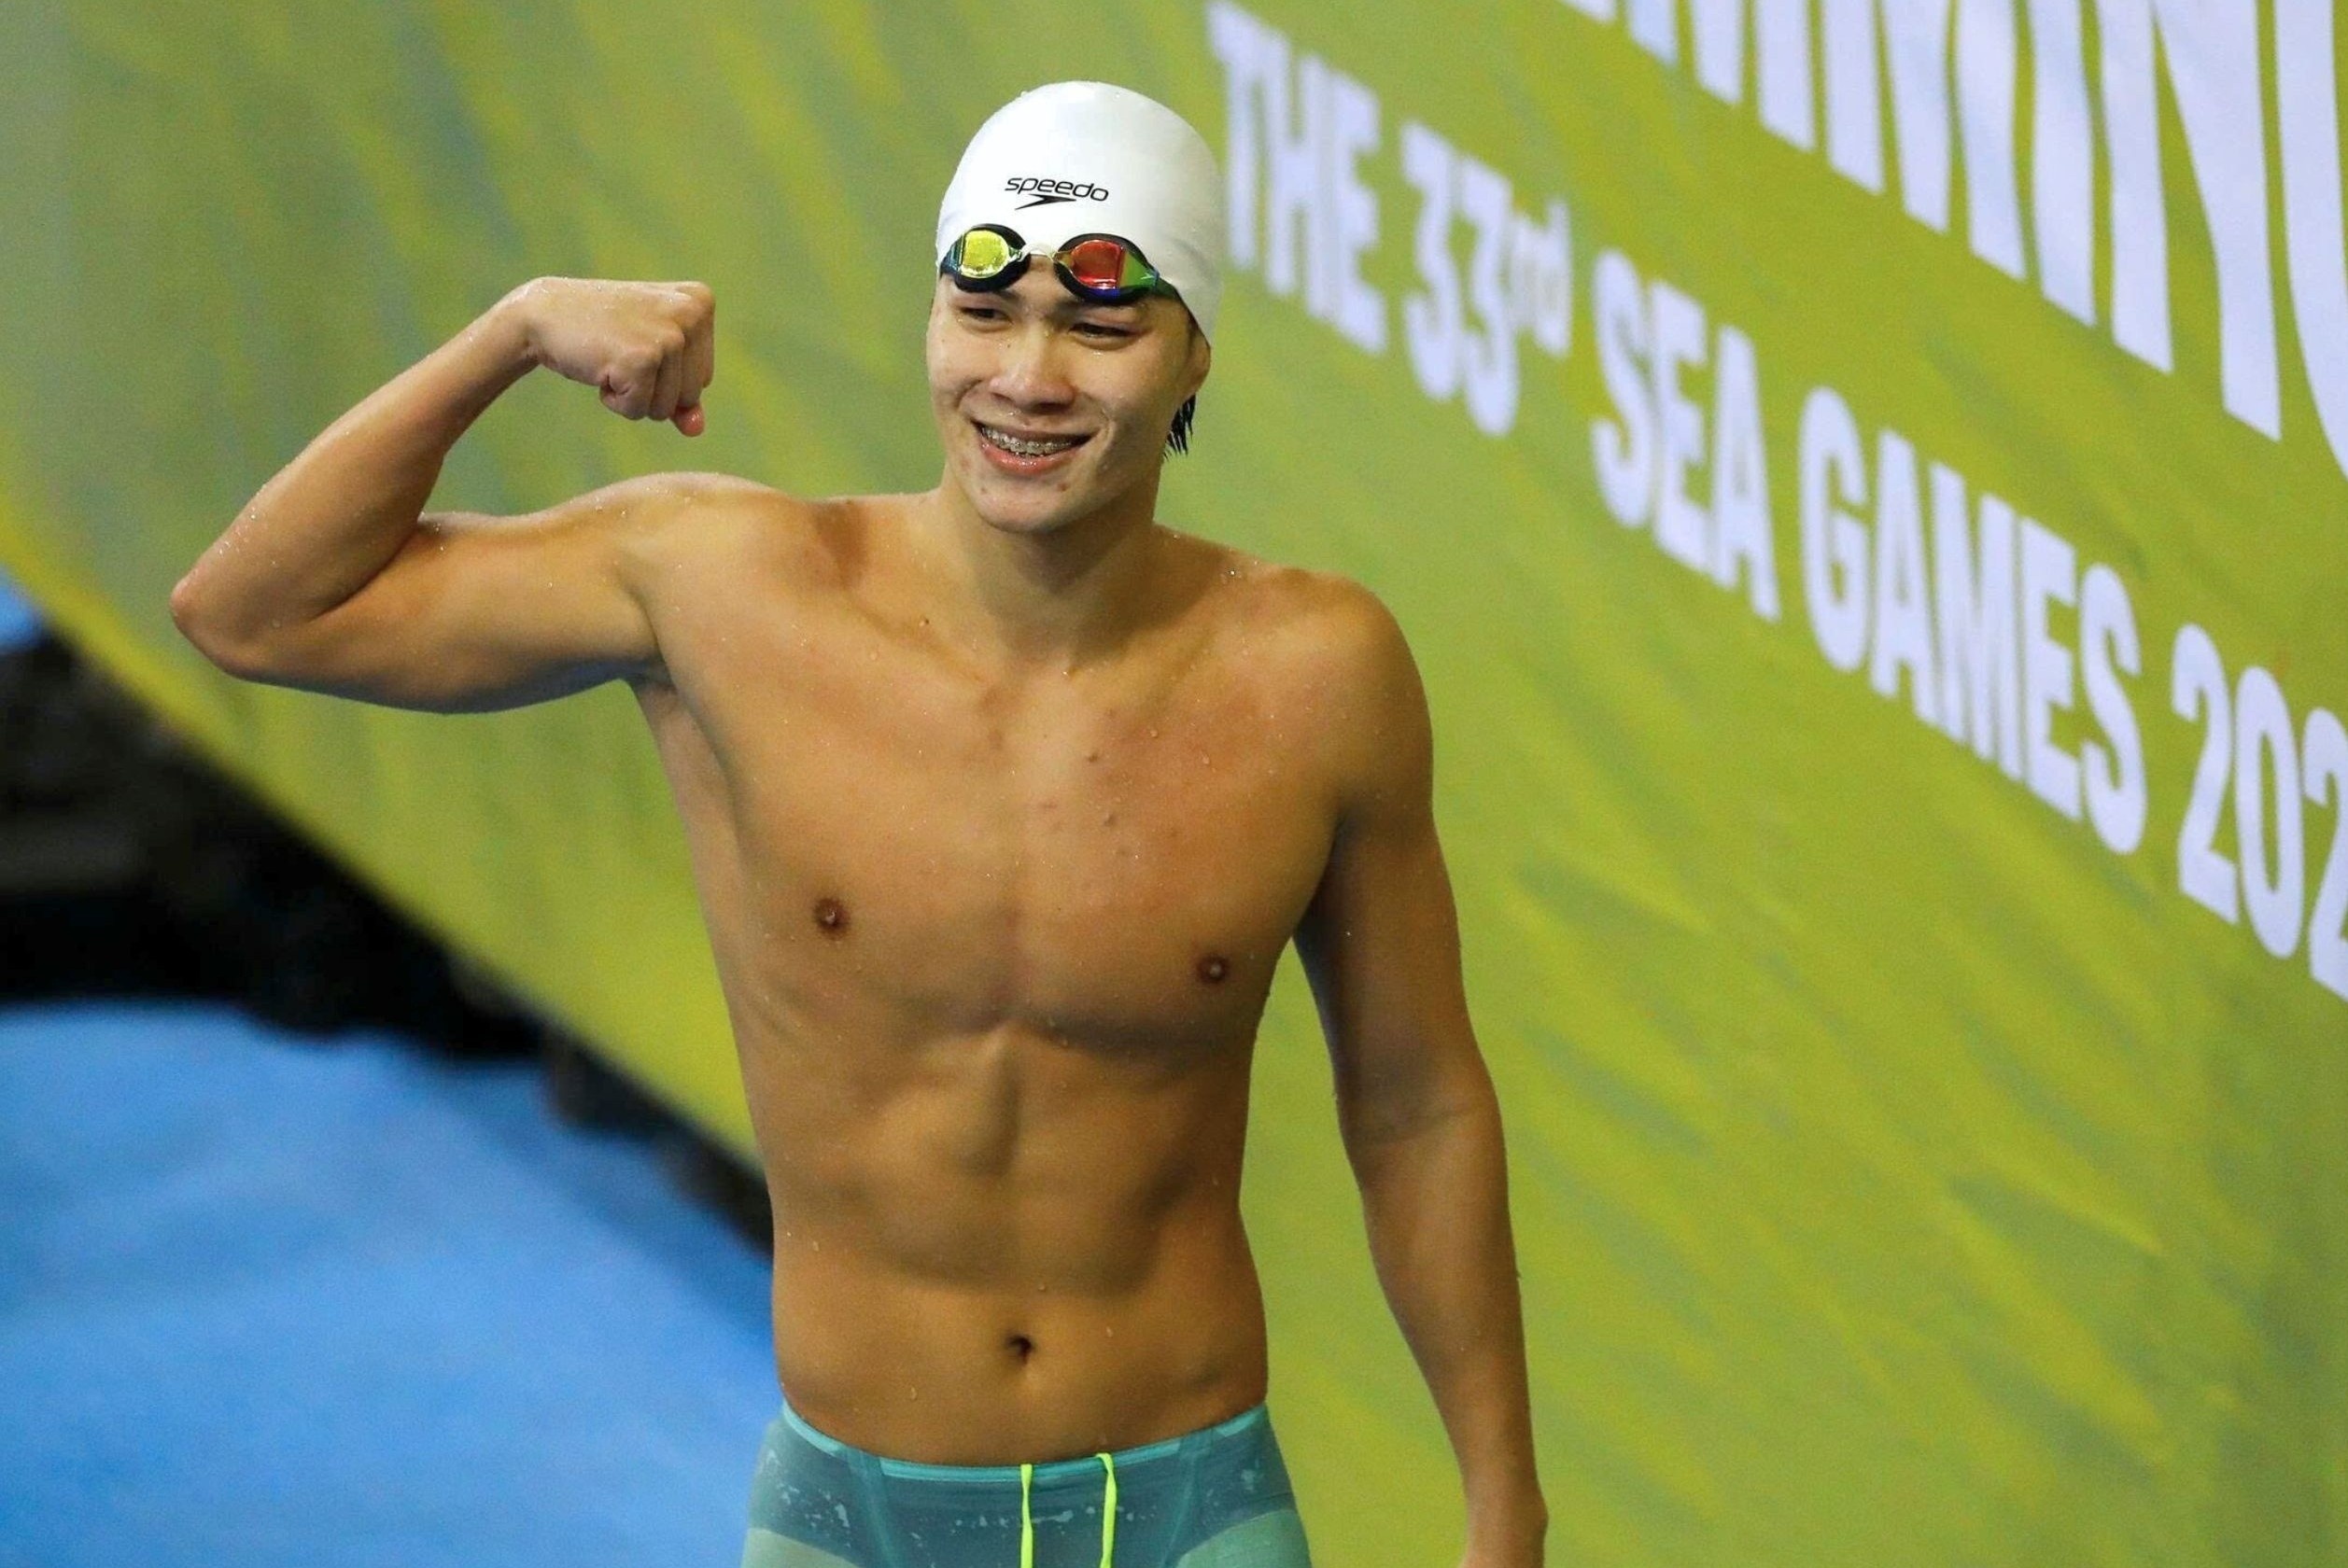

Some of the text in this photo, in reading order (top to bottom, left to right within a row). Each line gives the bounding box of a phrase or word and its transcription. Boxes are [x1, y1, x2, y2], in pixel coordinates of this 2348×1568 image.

[1005, 177, 1109, 202] speedo
[1203, 0, 1388, 354] THE
[1400, 121, 1573, 437] 33rd
[1591, 249, 1779, 621] SEA
[1799, 385, 2147, 854] GAMES
[2172, 623, 2348, 1001] 202
